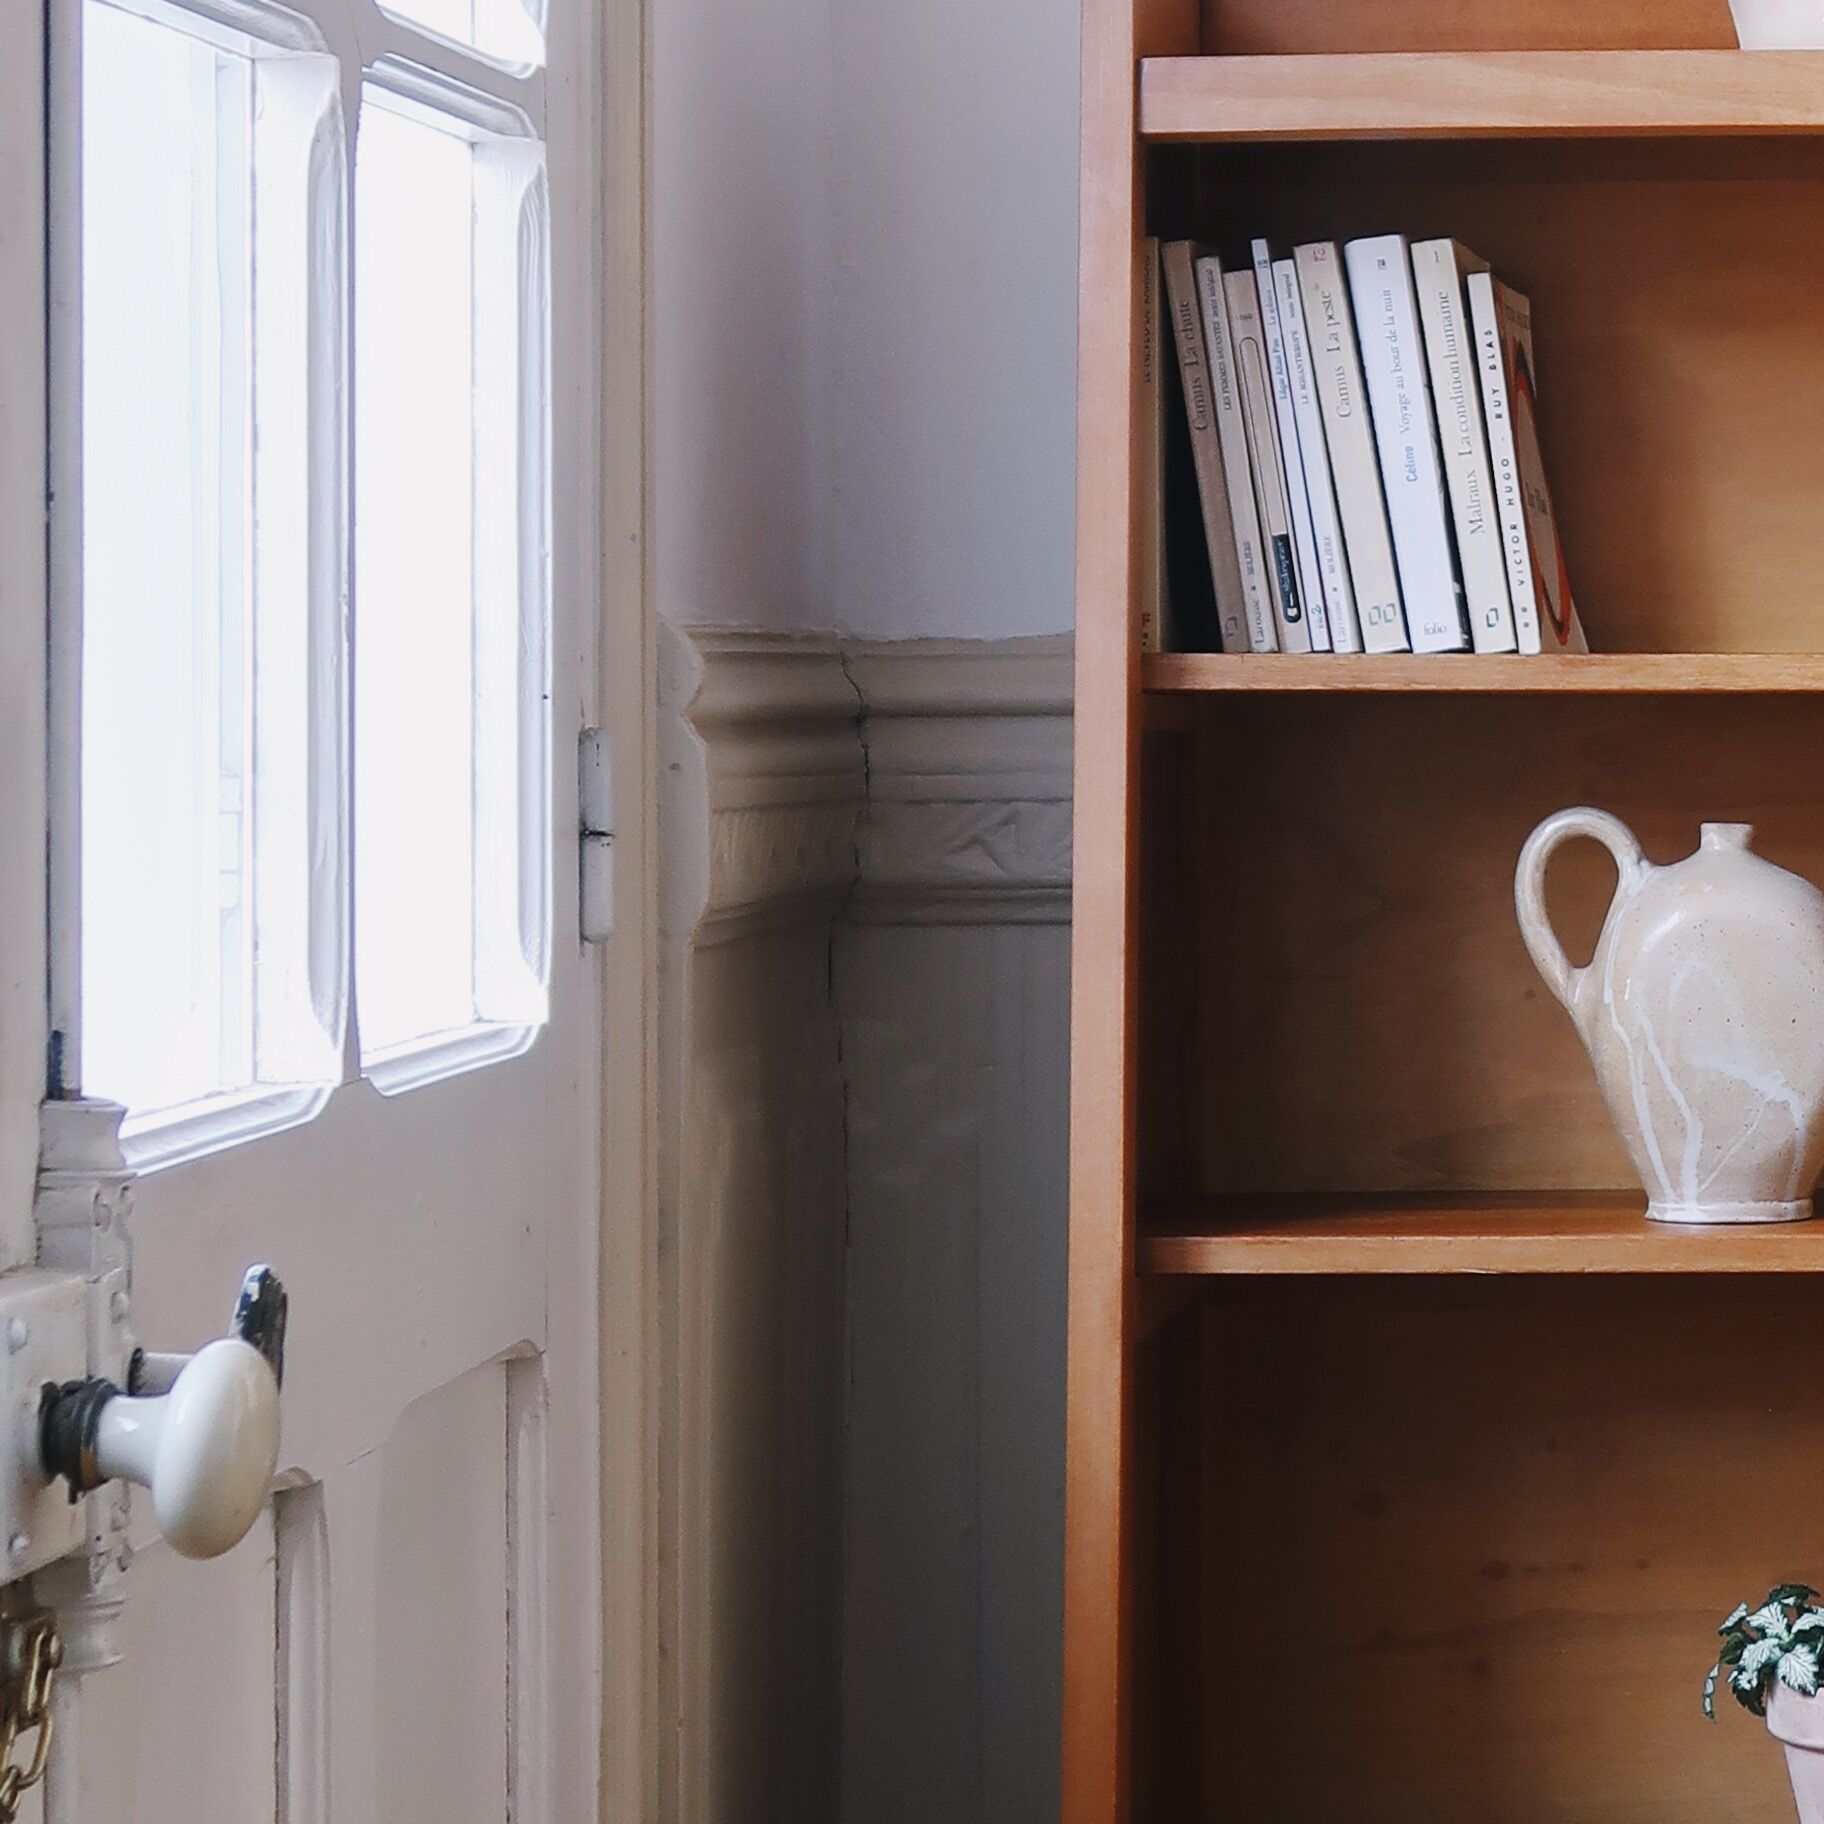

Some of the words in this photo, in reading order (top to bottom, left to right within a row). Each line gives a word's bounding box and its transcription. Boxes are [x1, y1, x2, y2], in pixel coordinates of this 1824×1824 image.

[1321, 291, 1340, 327] peste
[1380, 289, 1393, 312] nuit
[1383, 315, 1395, 327] la
[1386, 329, 1398, 343] de
[1437, 291, 1458, 359] humaine
[1184, 346, 1198, 367] La
[1327, 332, 1340, 352] La
[1484, 330, 1497, 371] BLAS
[1391, 346, 1402, 374] bout
[1336, 365, 1351, 418] Camus
[1396, 375, 1405, 389] au
[1447, 360, 1469, 433] condition
[1191, 377, 1207, 430] Camus
[1400, 392, 1412, 434] Voyage
[1491, 387, 1503, 419] RUY
[1458, 435, 1472, 457] La
[1501, 458, 1515, 506] HUGO
[1466, 469, 1485, 536] Malraux
[1510, 524, 1525, 586] VICTOR
[1423, 623, 1447, 636] folio
